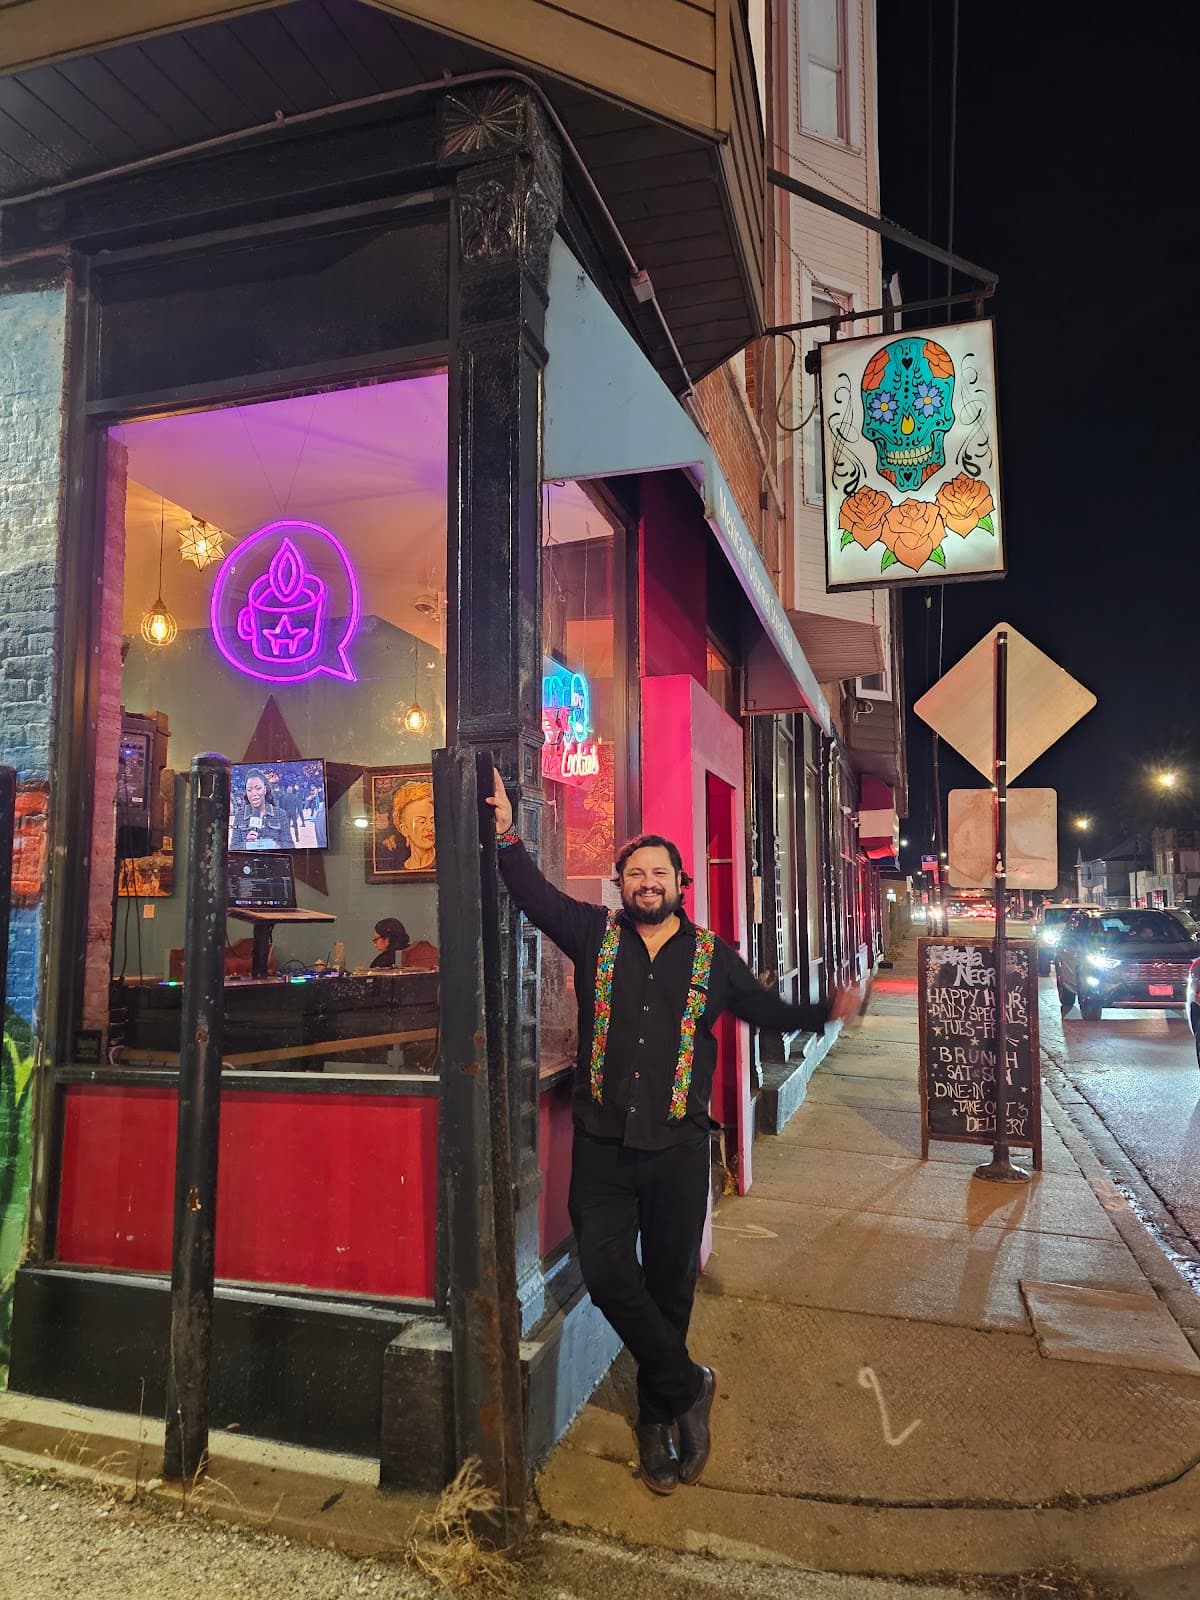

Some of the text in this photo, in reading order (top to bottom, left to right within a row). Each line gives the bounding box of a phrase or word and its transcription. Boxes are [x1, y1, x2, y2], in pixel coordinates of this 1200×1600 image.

[719, 486, 748, 569] Mexican
[953, 961, 997, 987] NEGR
[926, 987, 981, 1007] HAPPY
[931, 1003, 1029, 1025] DAILY SPECLS
[939, 1046, 1020, 1069] BRUNH
[946, 1064, 975, 1081] SAT
[953, 1099, 984, 1116] TAKE
[966, 1113, 1026, 1137] DELIERY
